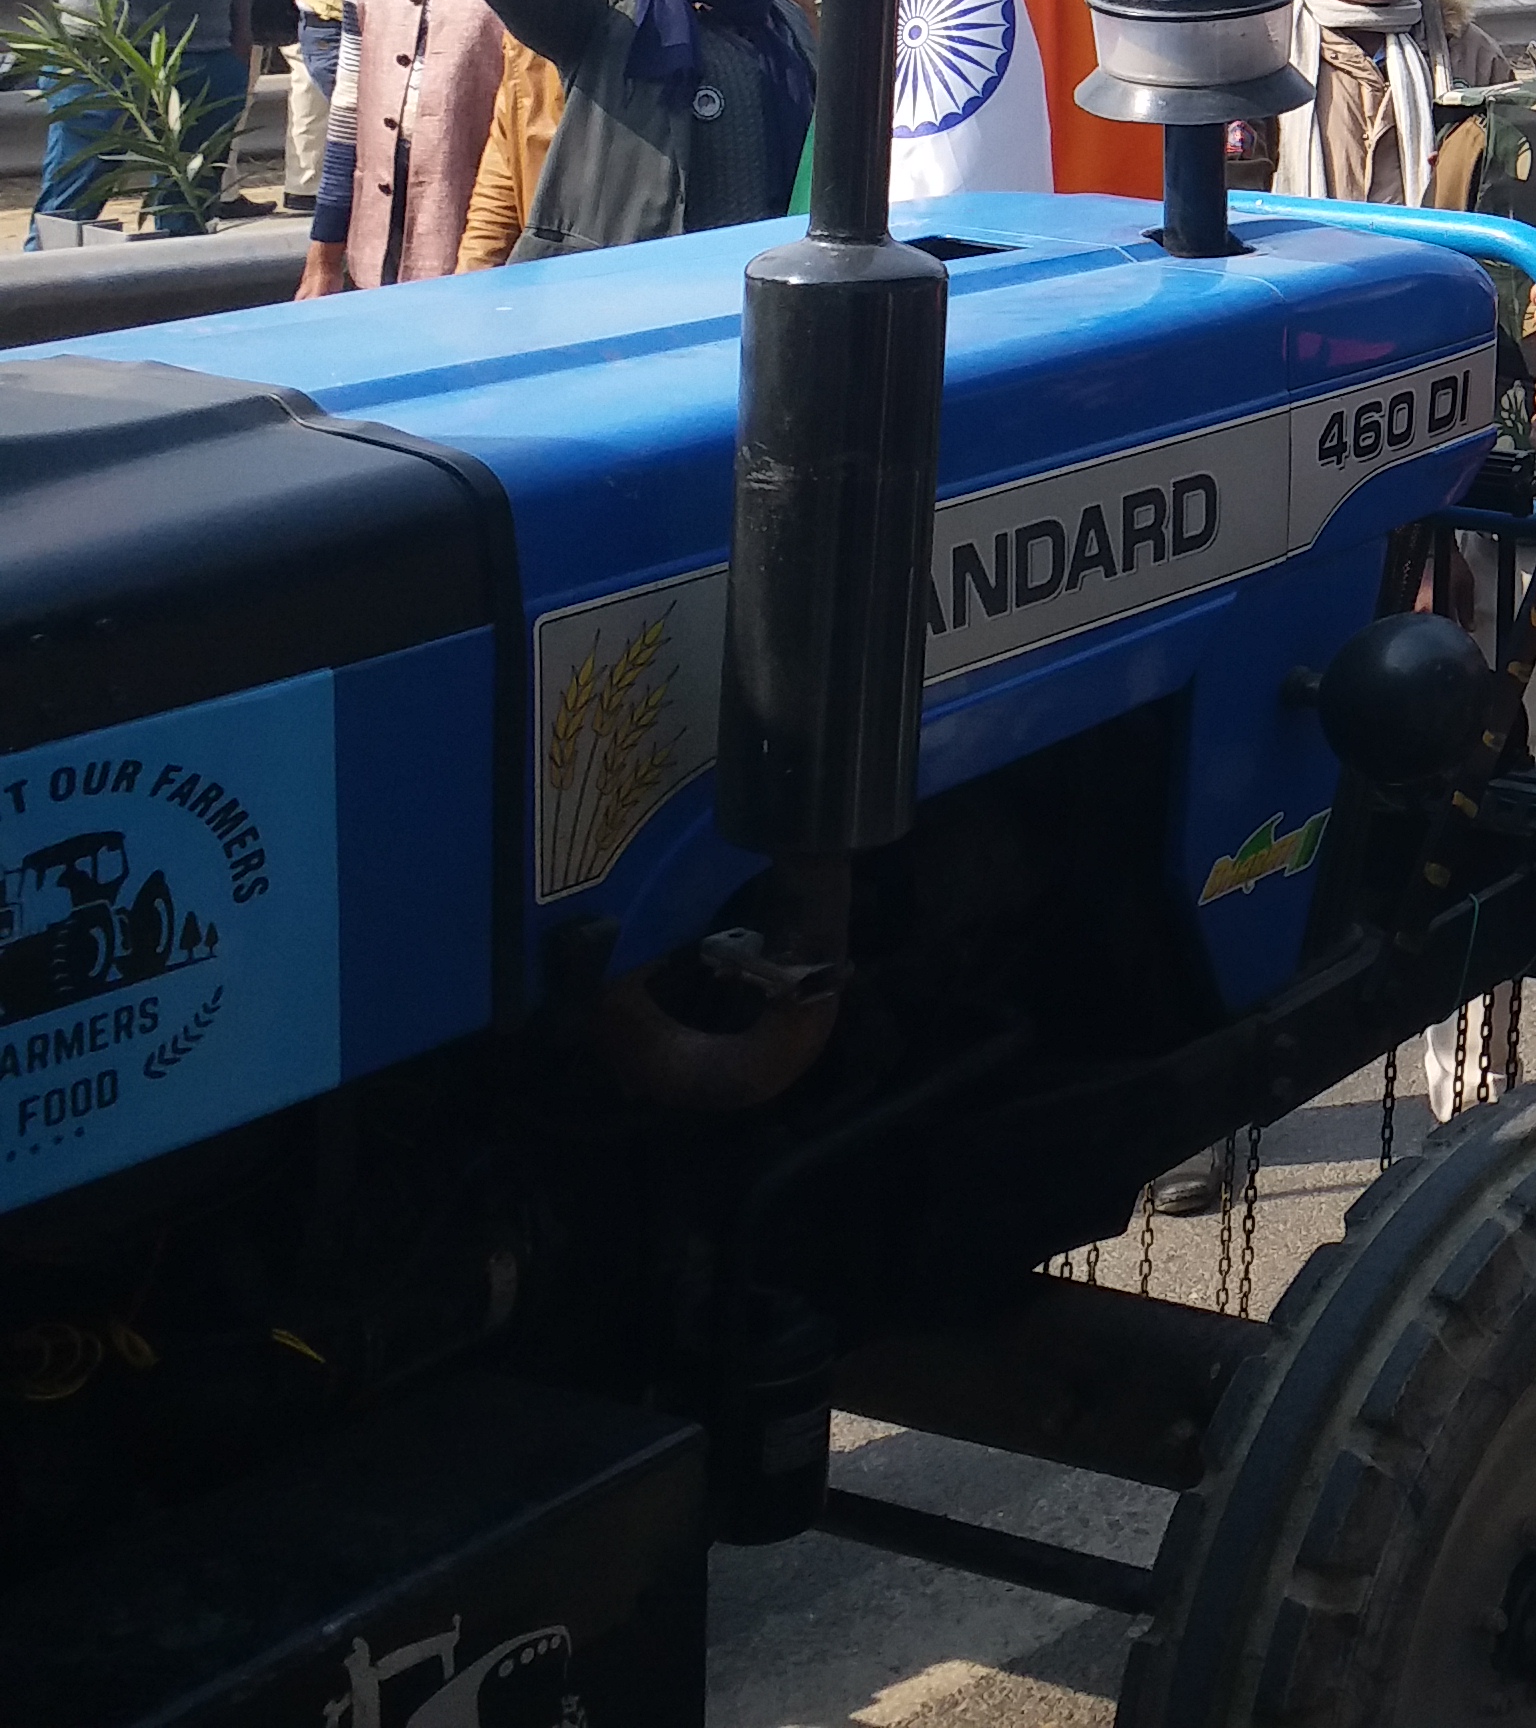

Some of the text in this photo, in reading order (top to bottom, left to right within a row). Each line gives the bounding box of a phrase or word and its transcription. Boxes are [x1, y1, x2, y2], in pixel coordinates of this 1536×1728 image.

[1317, 369, 1471, 472] 460 DI
[49, 759, 143, 803] OUR
[148, 763, 270, 904] FARMERS
[17, 1068, 118, 1137] FOOD
